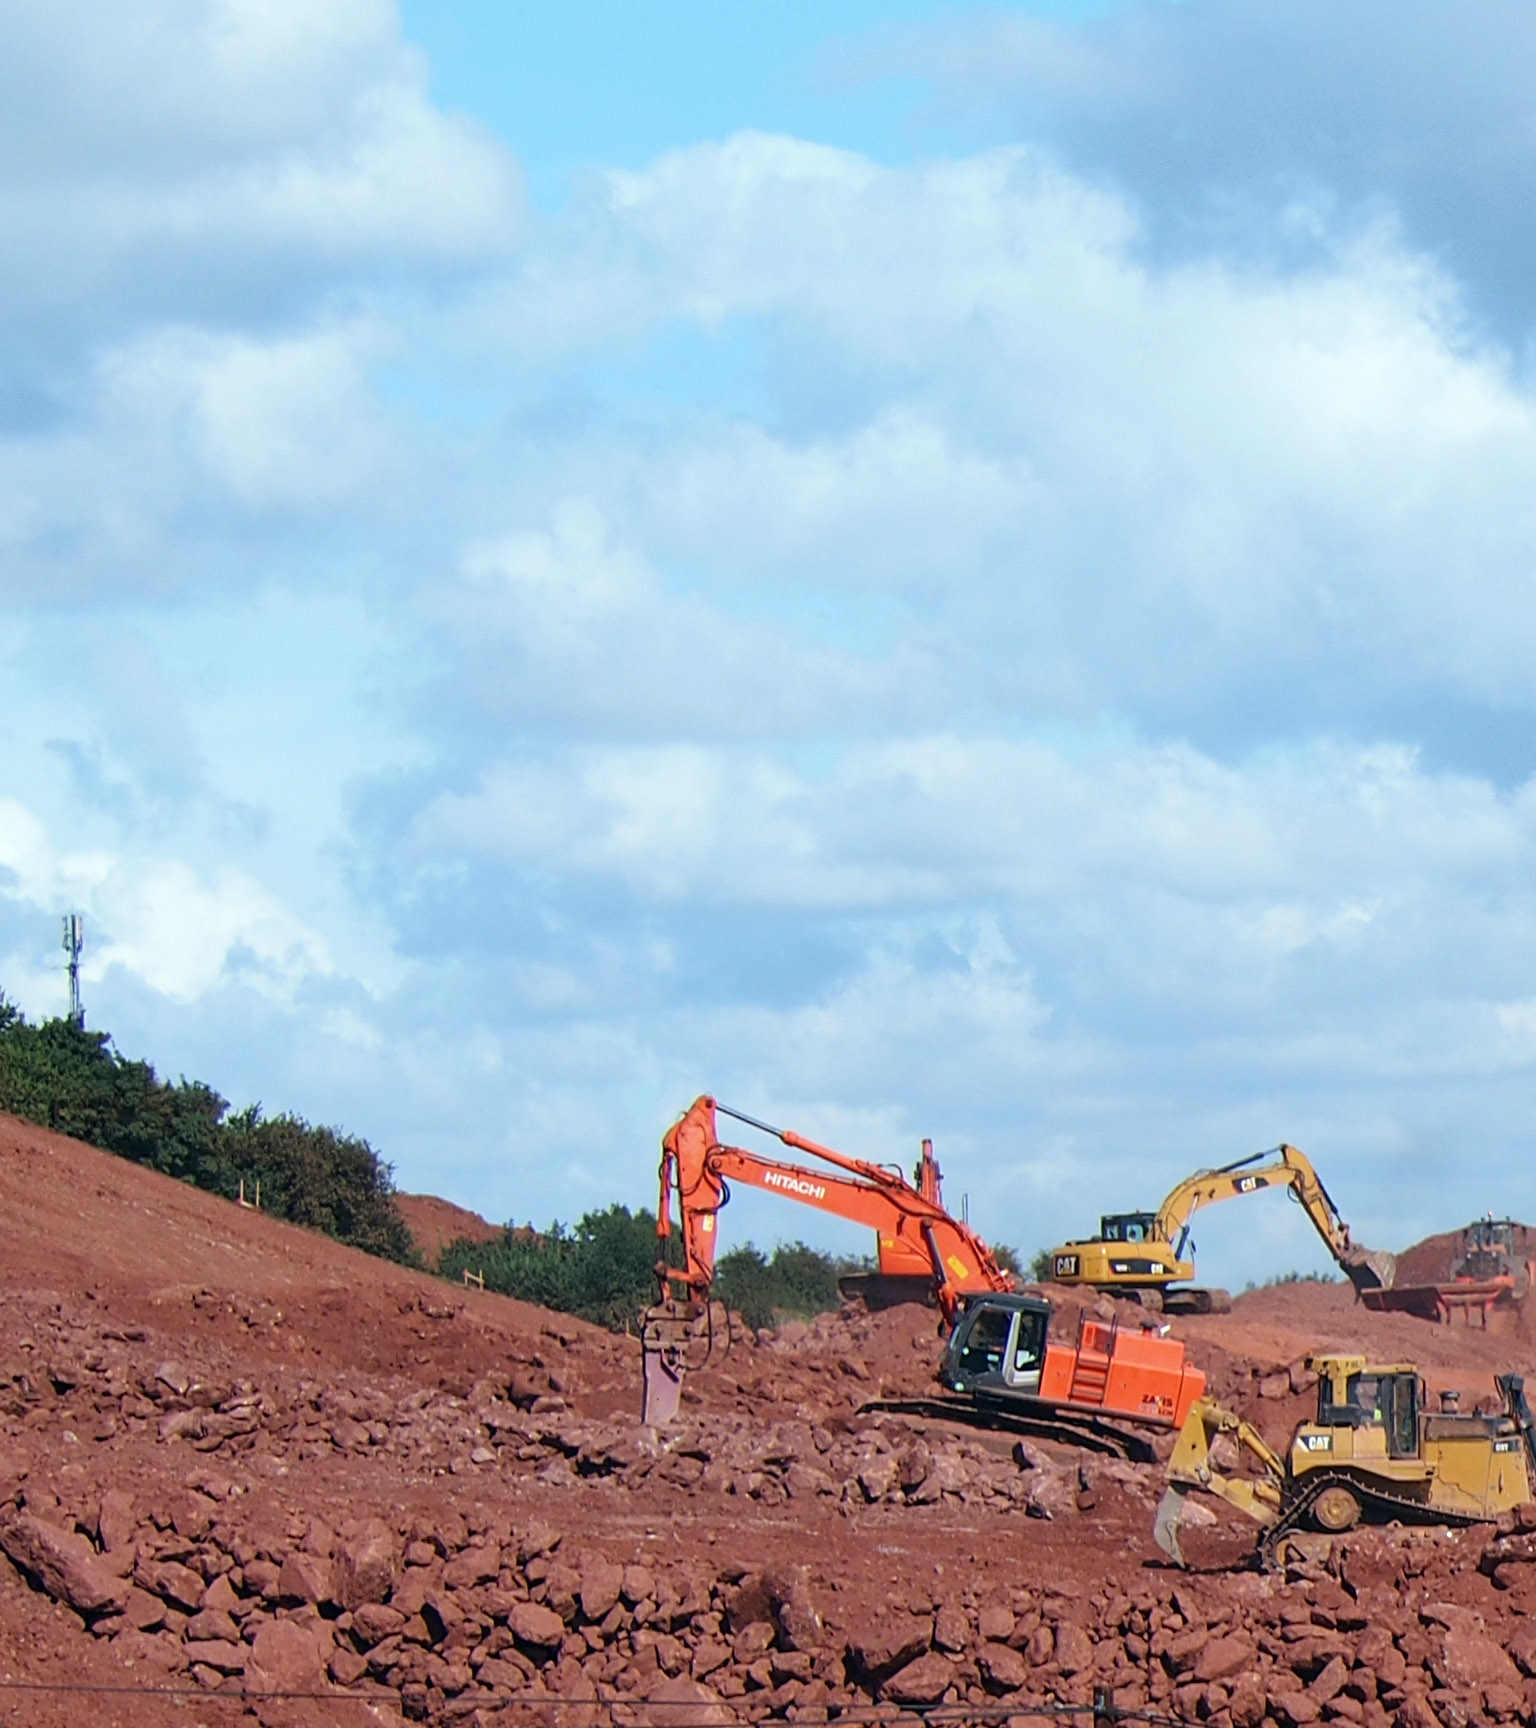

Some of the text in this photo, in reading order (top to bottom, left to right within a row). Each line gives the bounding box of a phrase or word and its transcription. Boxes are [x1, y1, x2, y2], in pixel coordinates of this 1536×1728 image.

[764, 1171, 826, 1199] HITACHI
[1057, 1257, 1076, 1275] CAT
[1309, 1436, 1330, 1450] CAT
